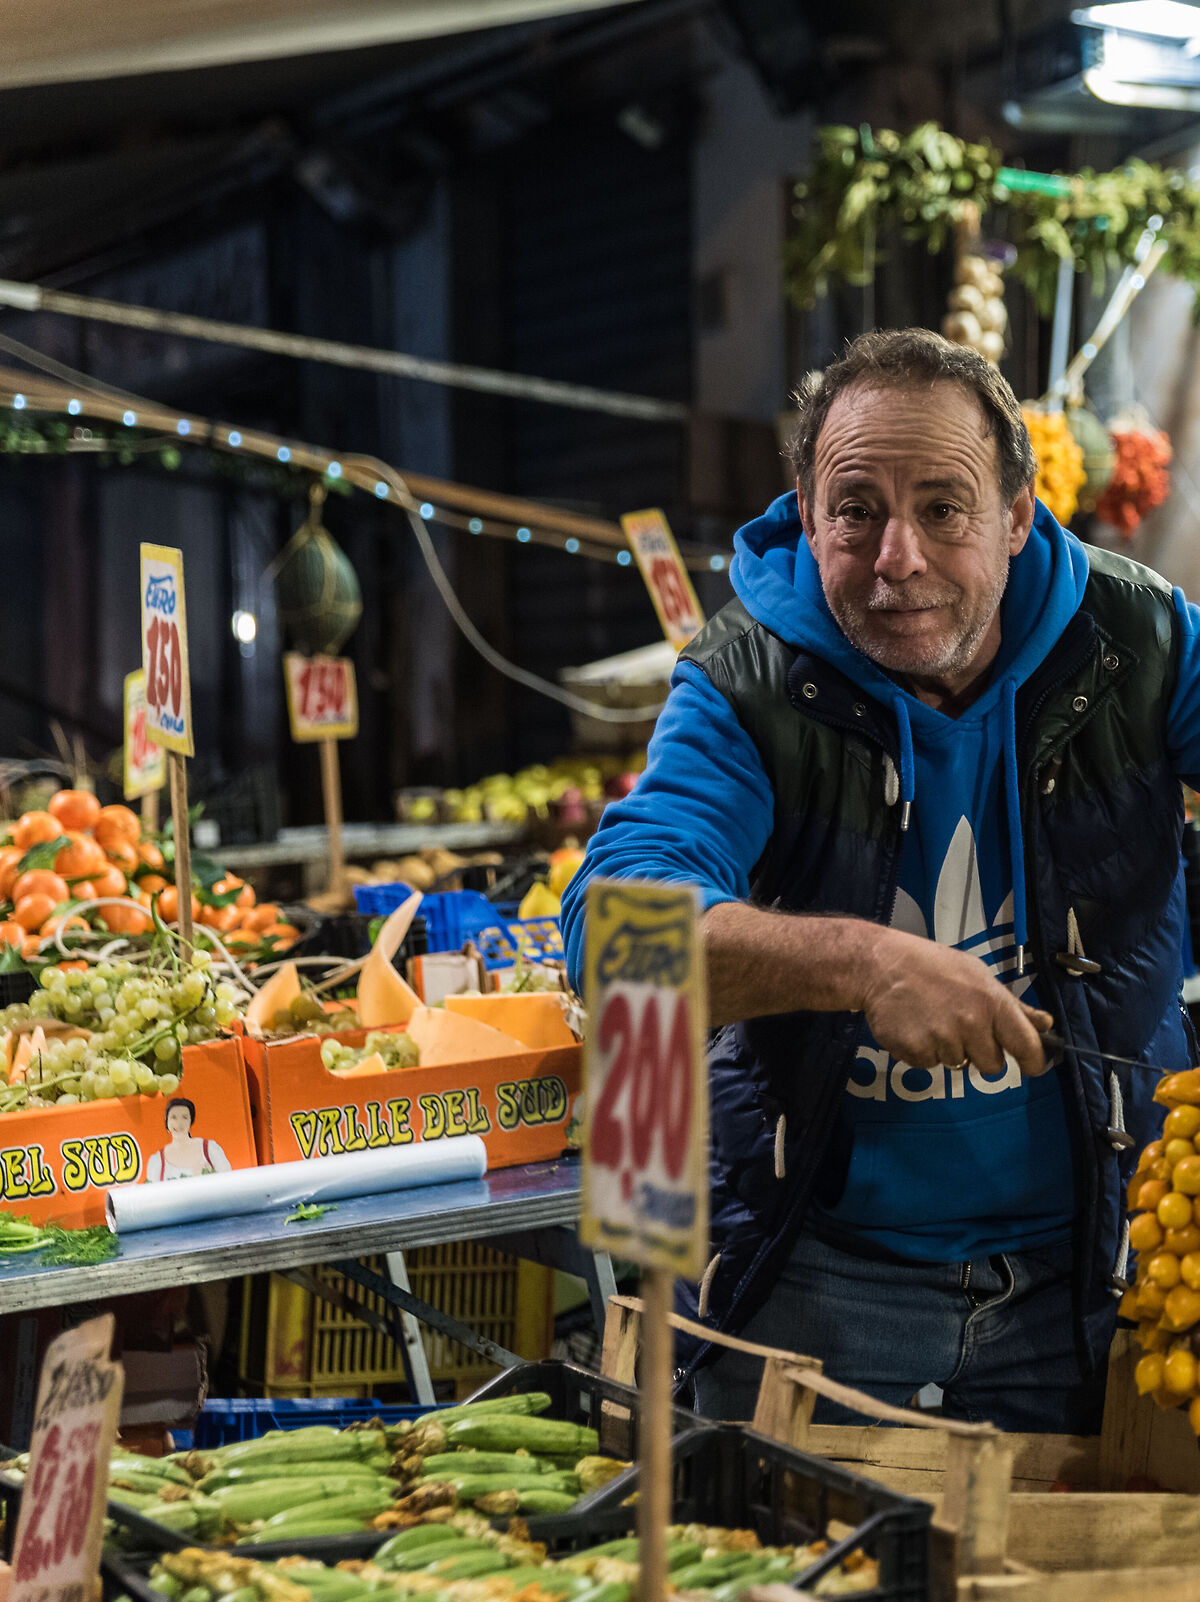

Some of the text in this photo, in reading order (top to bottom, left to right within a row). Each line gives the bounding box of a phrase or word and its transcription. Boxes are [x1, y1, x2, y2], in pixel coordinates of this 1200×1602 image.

[145, 575, 176, 615] EURO
[290, 1074, 569, 1160] VALLE DEL SUD
[0, 1132, 141, 1201] EL SUD
